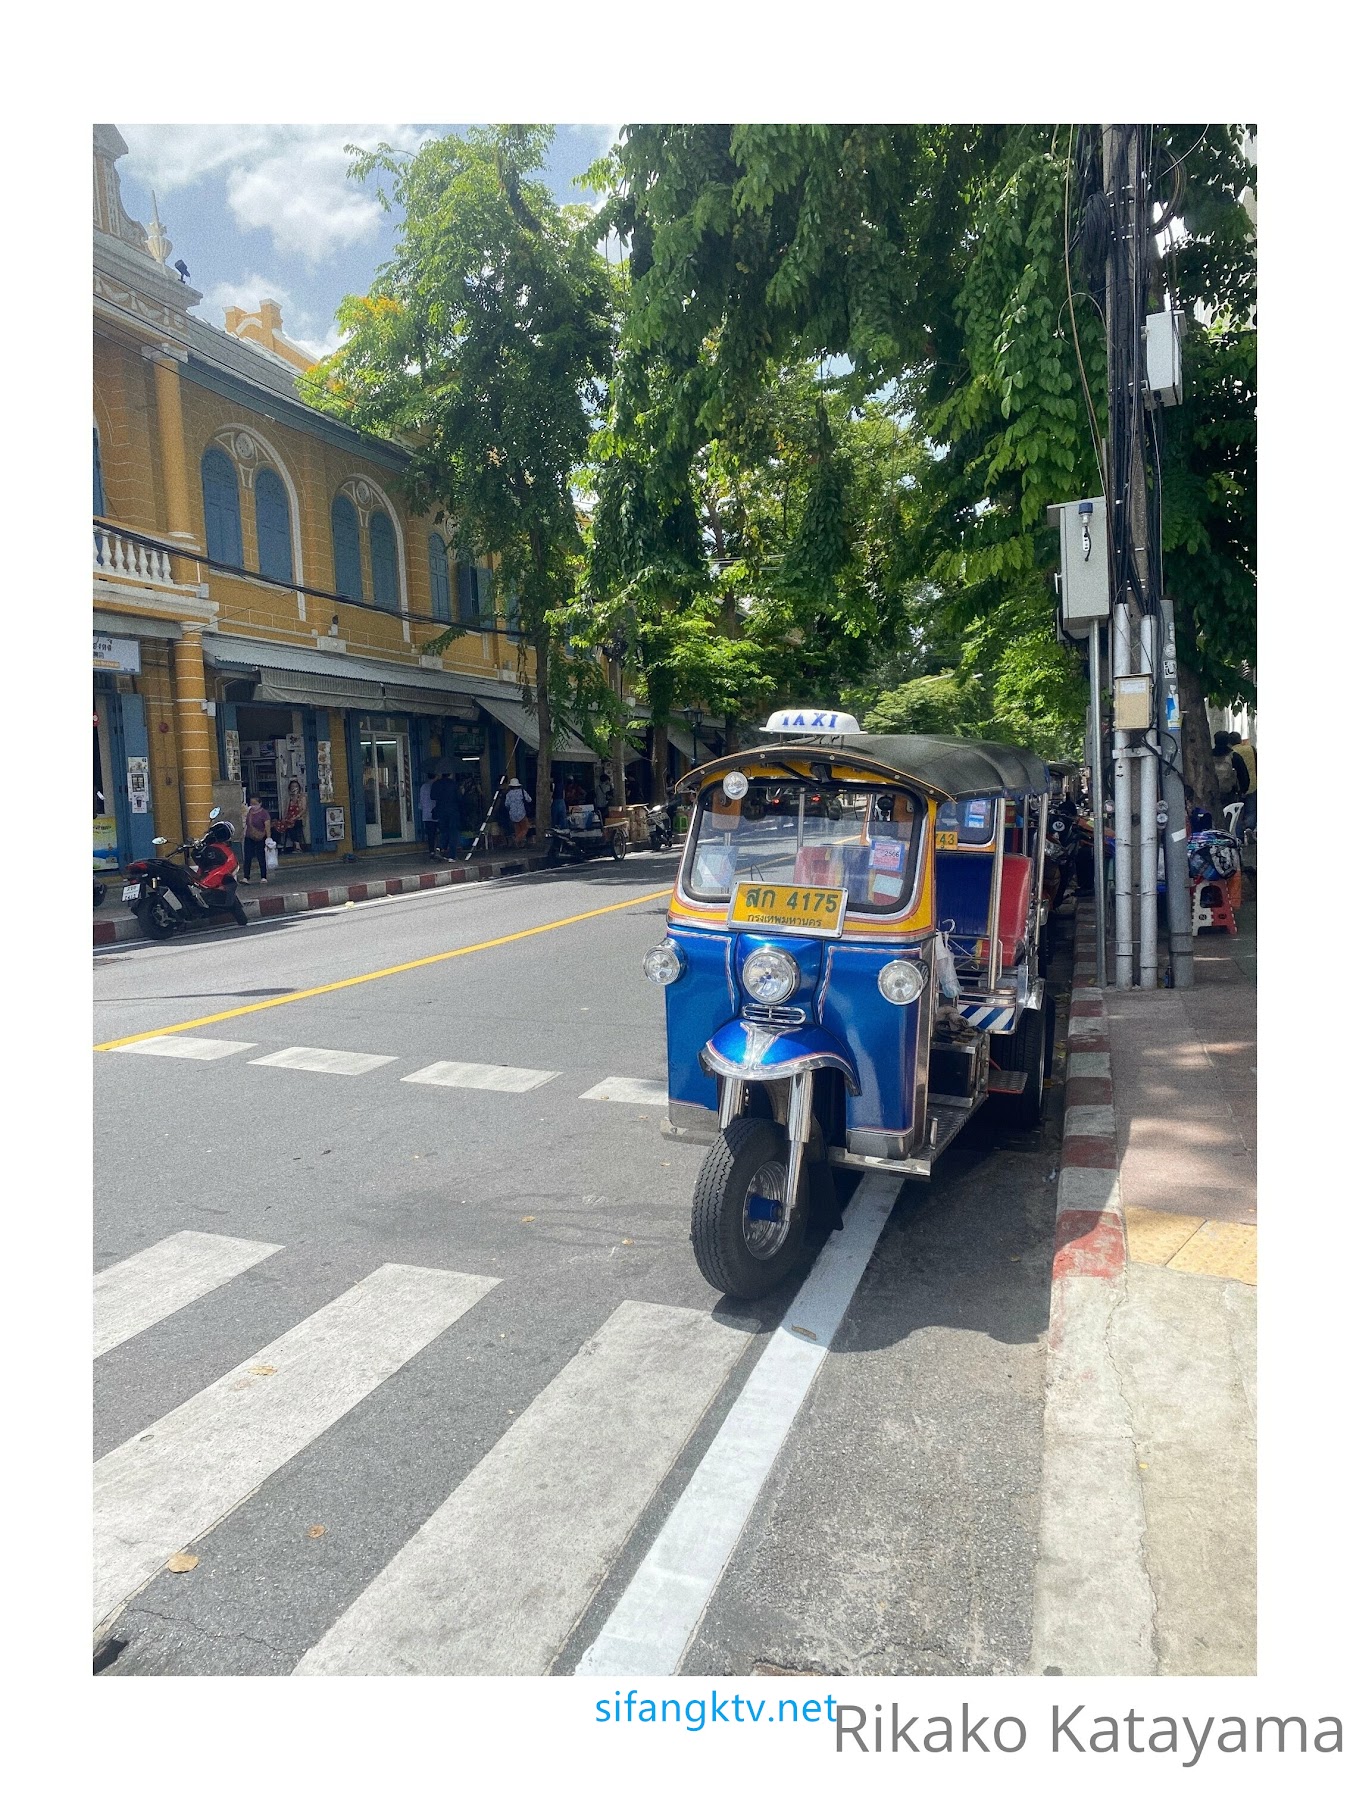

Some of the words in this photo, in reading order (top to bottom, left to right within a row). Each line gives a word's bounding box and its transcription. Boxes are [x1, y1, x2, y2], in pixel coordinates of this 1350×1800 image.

[781, 712, 838, 728] TAXI
[745, 887, 776, 908] สก
[786, 891, 839, 913] 4175
